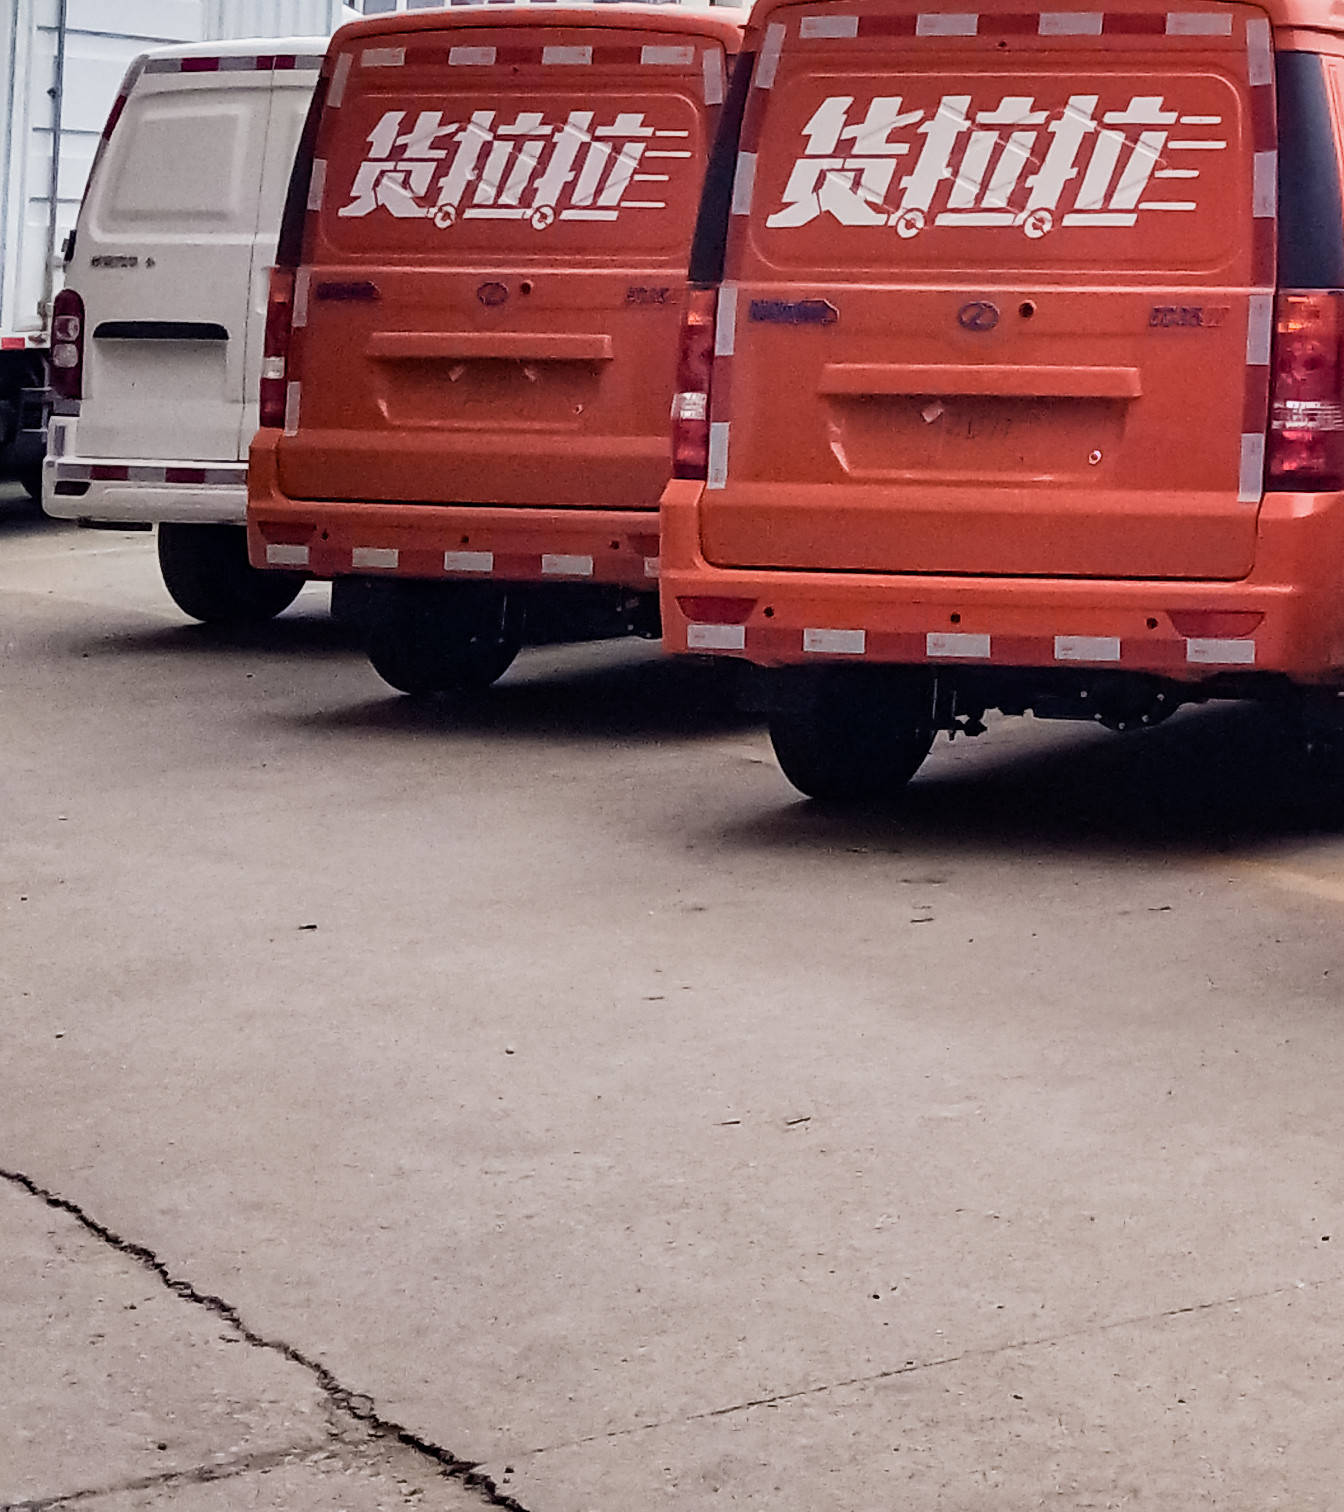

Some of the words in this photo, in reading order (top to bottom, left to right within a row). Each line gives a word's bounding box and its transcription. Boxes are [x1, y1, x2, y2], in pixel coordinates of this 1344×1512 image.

[338, 111, 654, 230] 货拉拉
[766, 95, 1178, 238] 货拉拉
